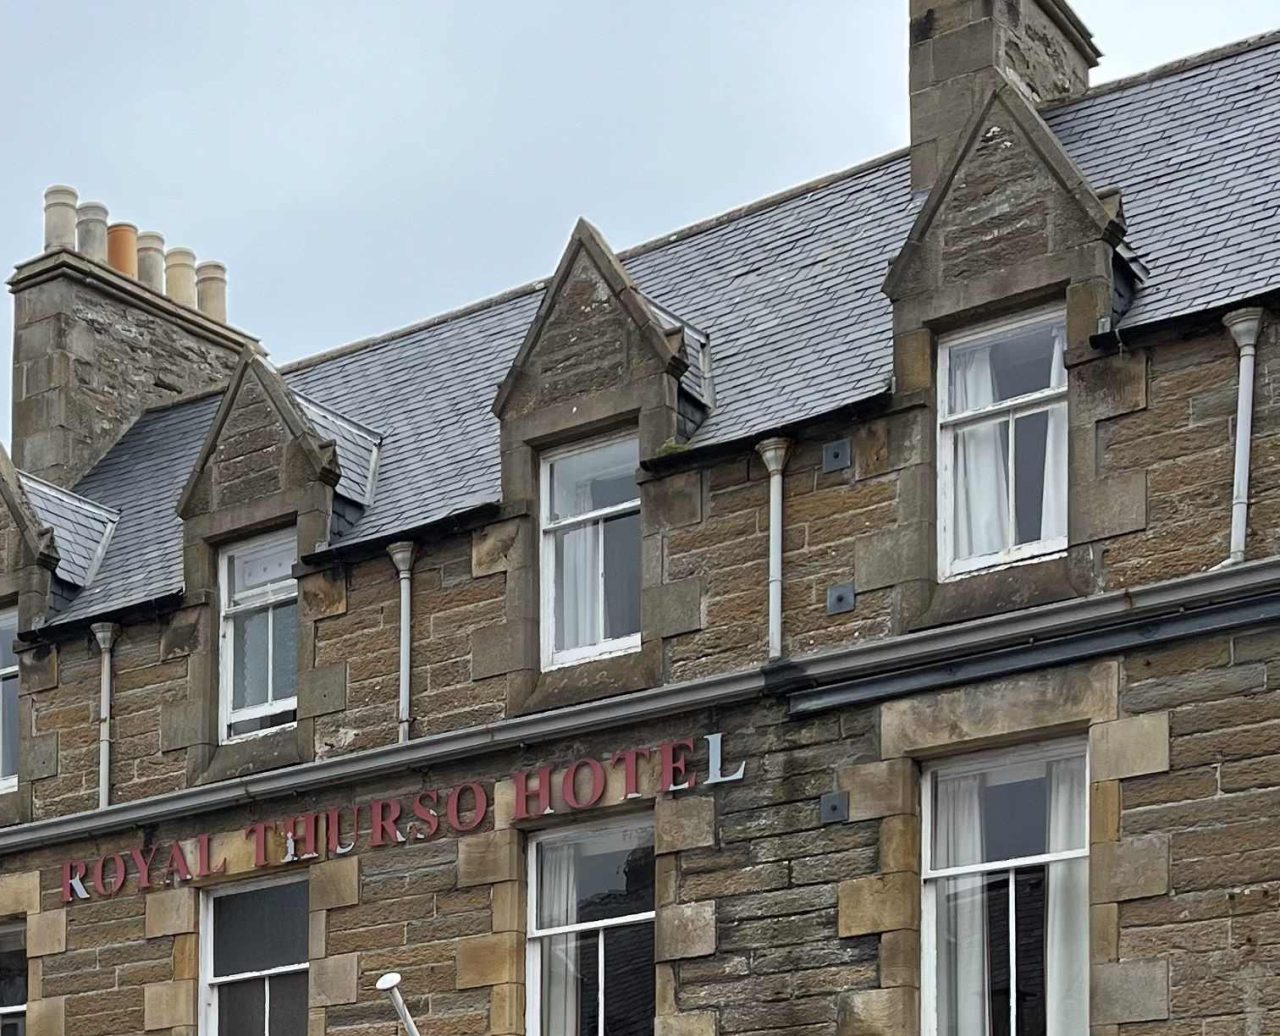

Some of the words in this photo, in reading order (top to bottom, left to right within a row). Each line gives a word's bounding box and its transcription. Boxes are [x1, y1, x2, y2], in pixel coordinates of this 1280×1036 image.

[61, 833, 226, 901] ROYAL
[244, 780, 488, 866] THURSO
[513, 732, 746, 820] HOTEL
